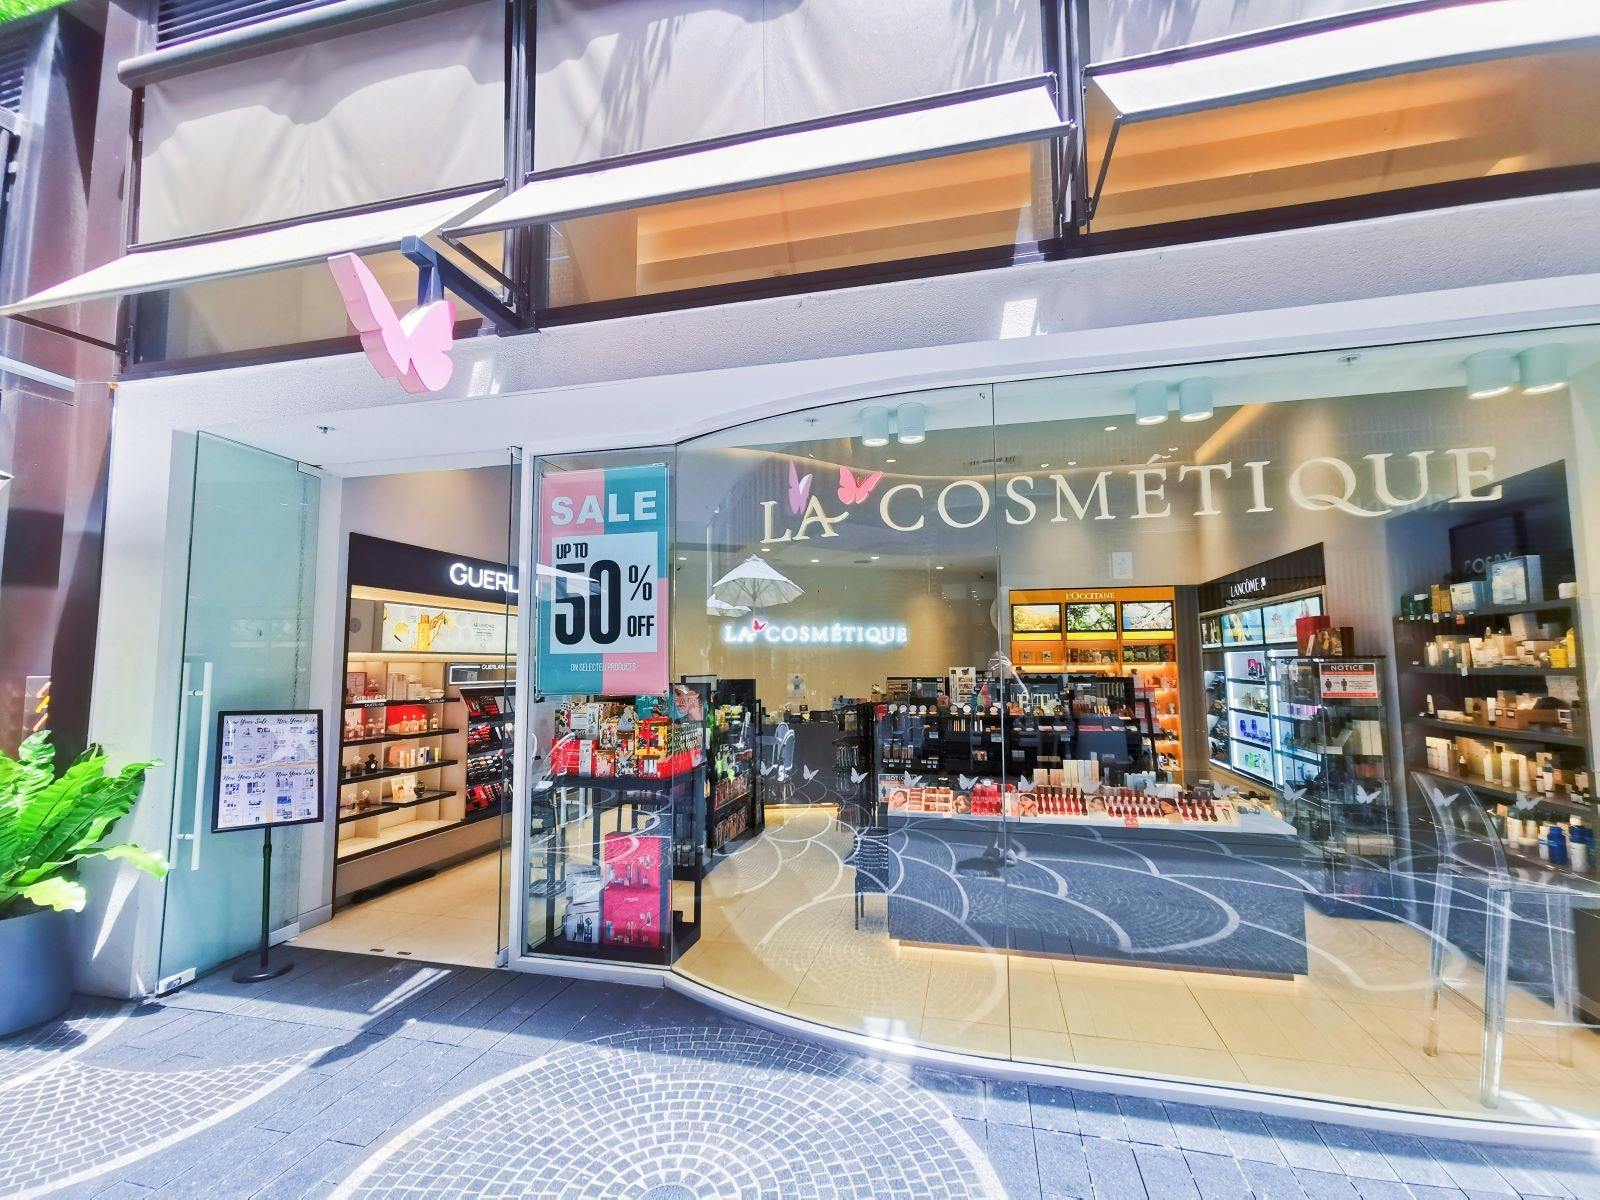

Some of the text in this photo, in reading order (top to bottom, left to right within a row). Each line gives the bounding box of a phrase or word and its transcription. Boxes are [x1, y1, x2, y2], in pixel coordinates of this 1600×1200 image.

[759, 446, 1503, 544] LA COSMÉTIQUE
[550, 490, 657, 526] SALE
[556, 542, 588, 560] UP TO
[627, 615, 655, 638] OFF
[723, 623, 908, 645] LA COSMÉTIQUE
